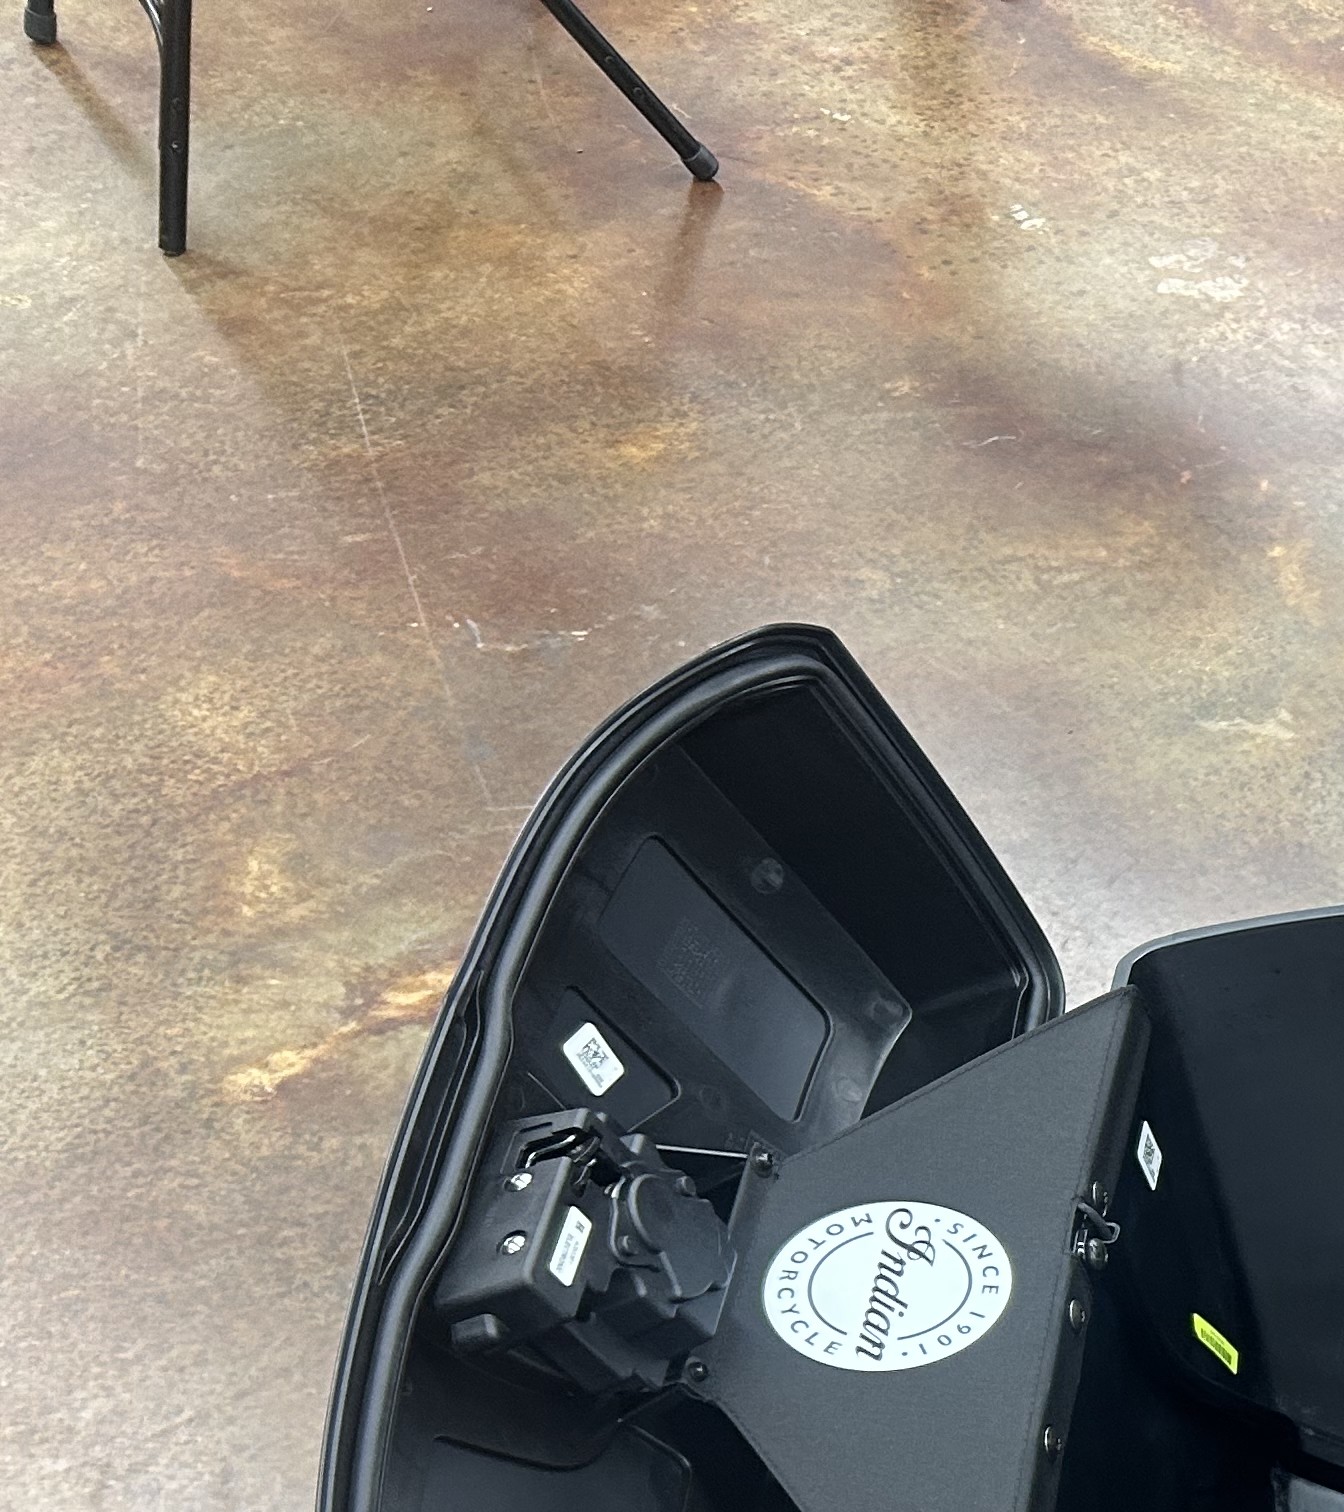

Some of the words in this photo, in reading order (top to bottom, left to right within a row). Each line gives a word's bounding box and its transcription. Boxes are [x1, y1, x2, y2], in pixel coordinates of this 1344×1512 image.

[777, 1213, 873, 1355] MOTORCYCLE
[855, 1208, 936, 1361] Indian
[947, 1222, 1000, 1294] SINCE
[918, 1311, 986, 1355] 1901
